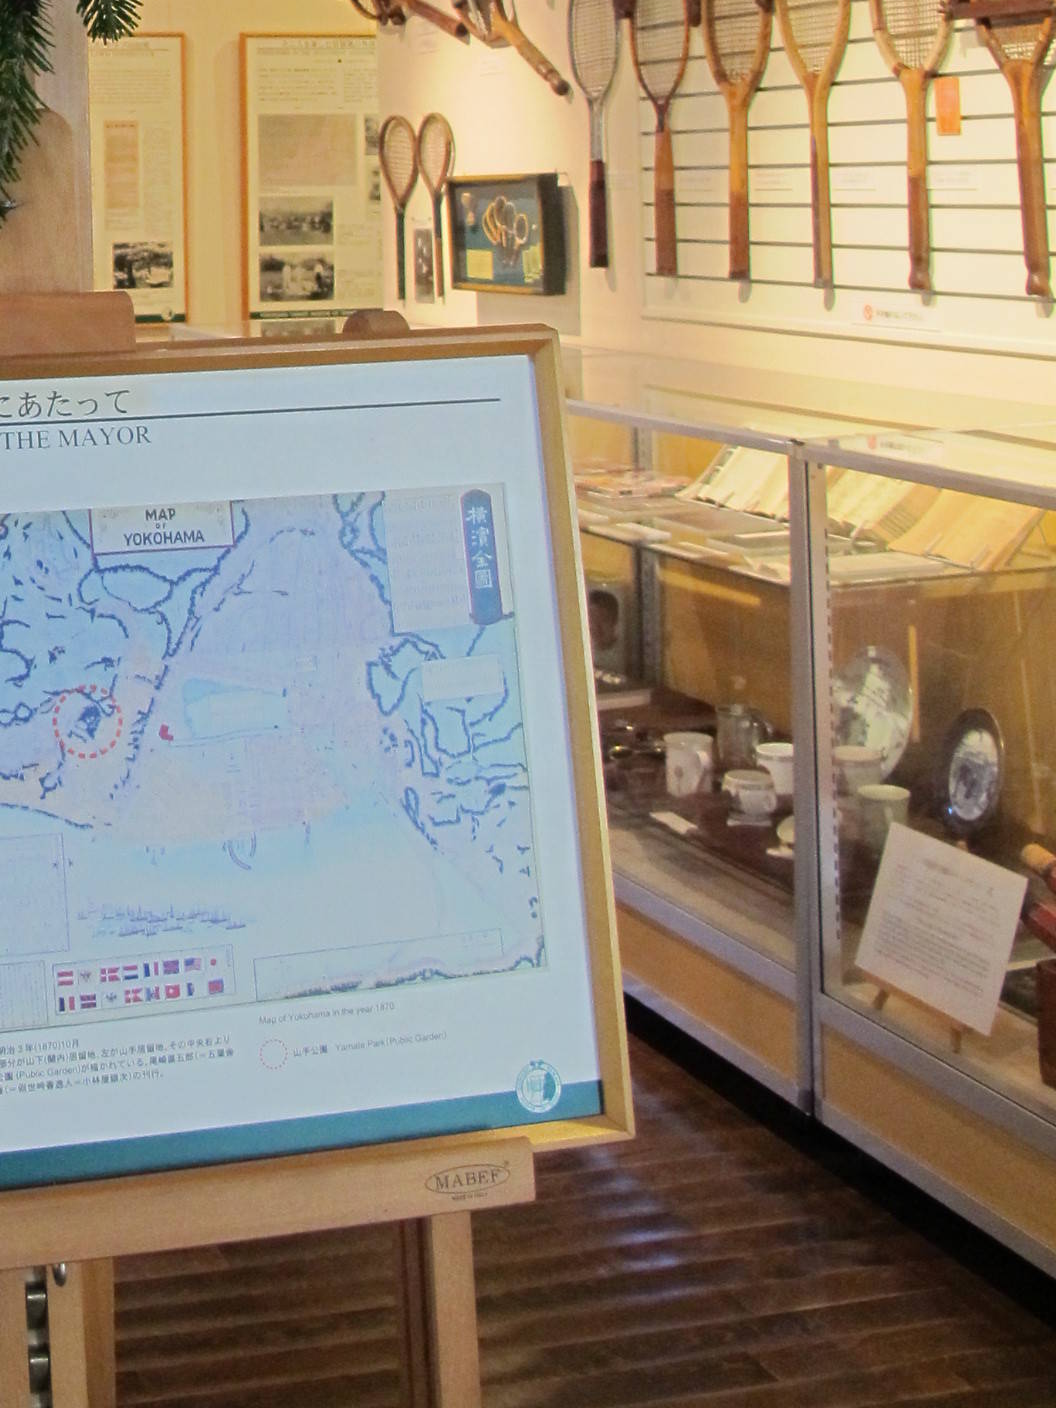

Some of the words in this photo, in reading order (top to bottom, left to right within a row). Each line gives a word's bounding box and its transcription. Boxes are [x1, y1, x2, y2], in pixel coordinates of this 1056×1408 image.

[57, 425, 152, 448] MAYOR
[144, 508, 176, 521] MAP
[123, 530, 206, 546] YOKOHAMA
[435, 1169, 500, 1190] MABEF
